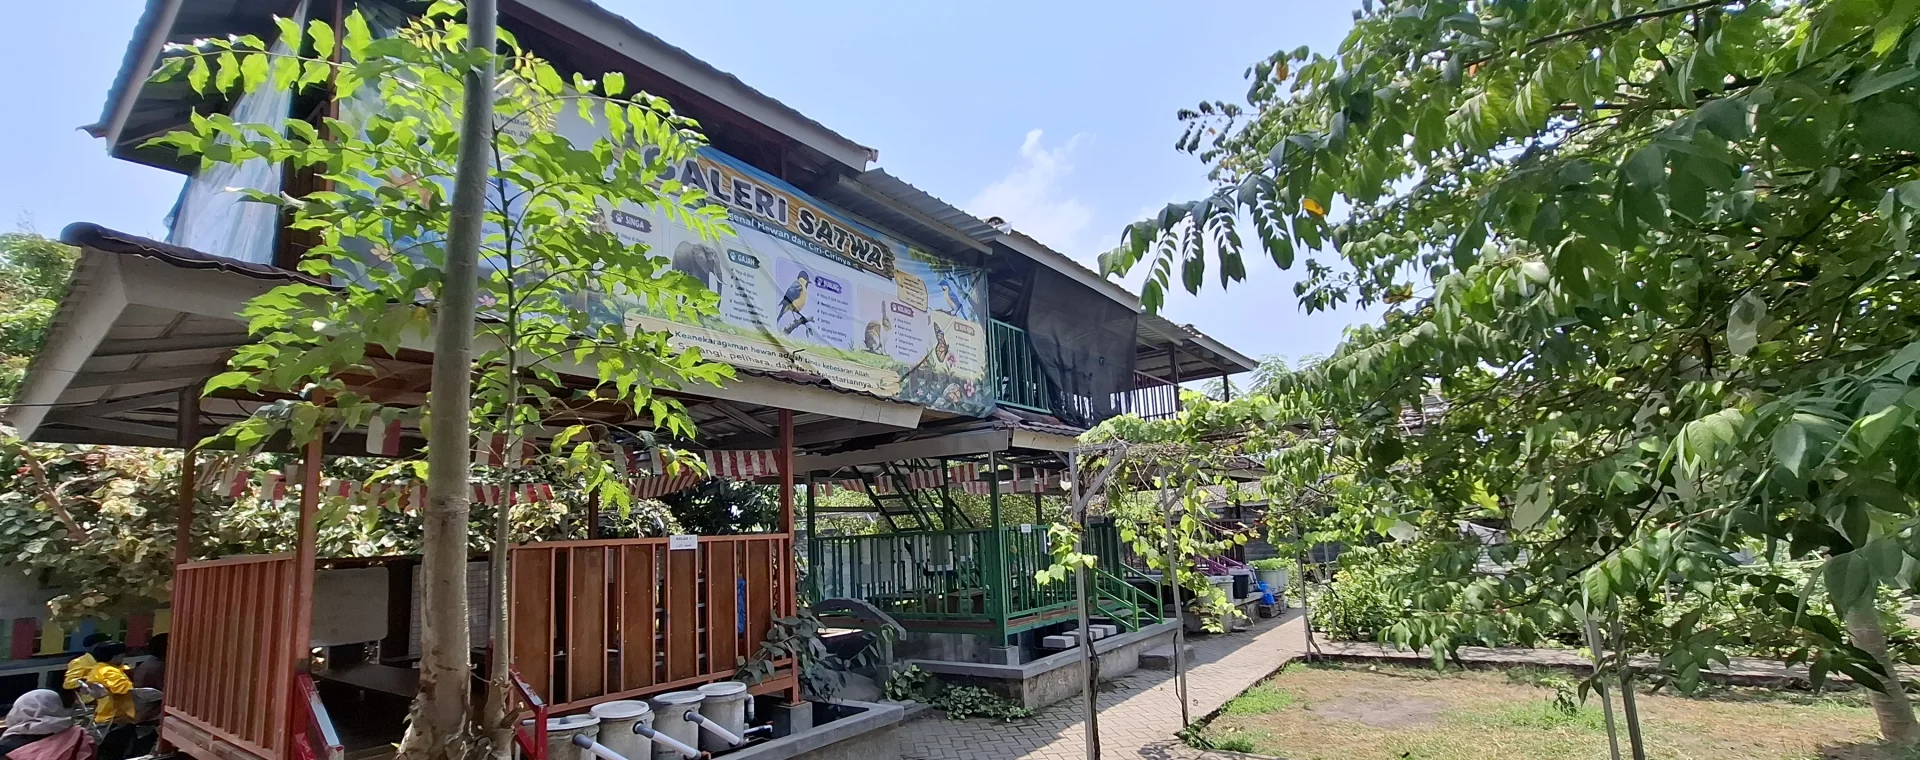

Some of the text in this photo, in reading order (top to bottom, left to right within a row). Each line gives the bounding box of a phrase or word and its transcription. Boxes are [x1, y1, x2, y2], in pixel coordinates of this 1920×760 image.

[625, 216, 645, 229] SINGA
[757, 220, 790, 240] Hewan
[791, 234, 807, 247] dan
[808, 242, 851, 266] Ciri-Cirinya
[798, 208, 883, 269] SATWA
[737, 254, 755, 266] GAJAH
[675, 330, 749, 351] Keanekaragaman
[750, 346, 777, 357] hewan
[822, 362, 854, 375] kebesaran
[775, 361, 793, 370] dan
